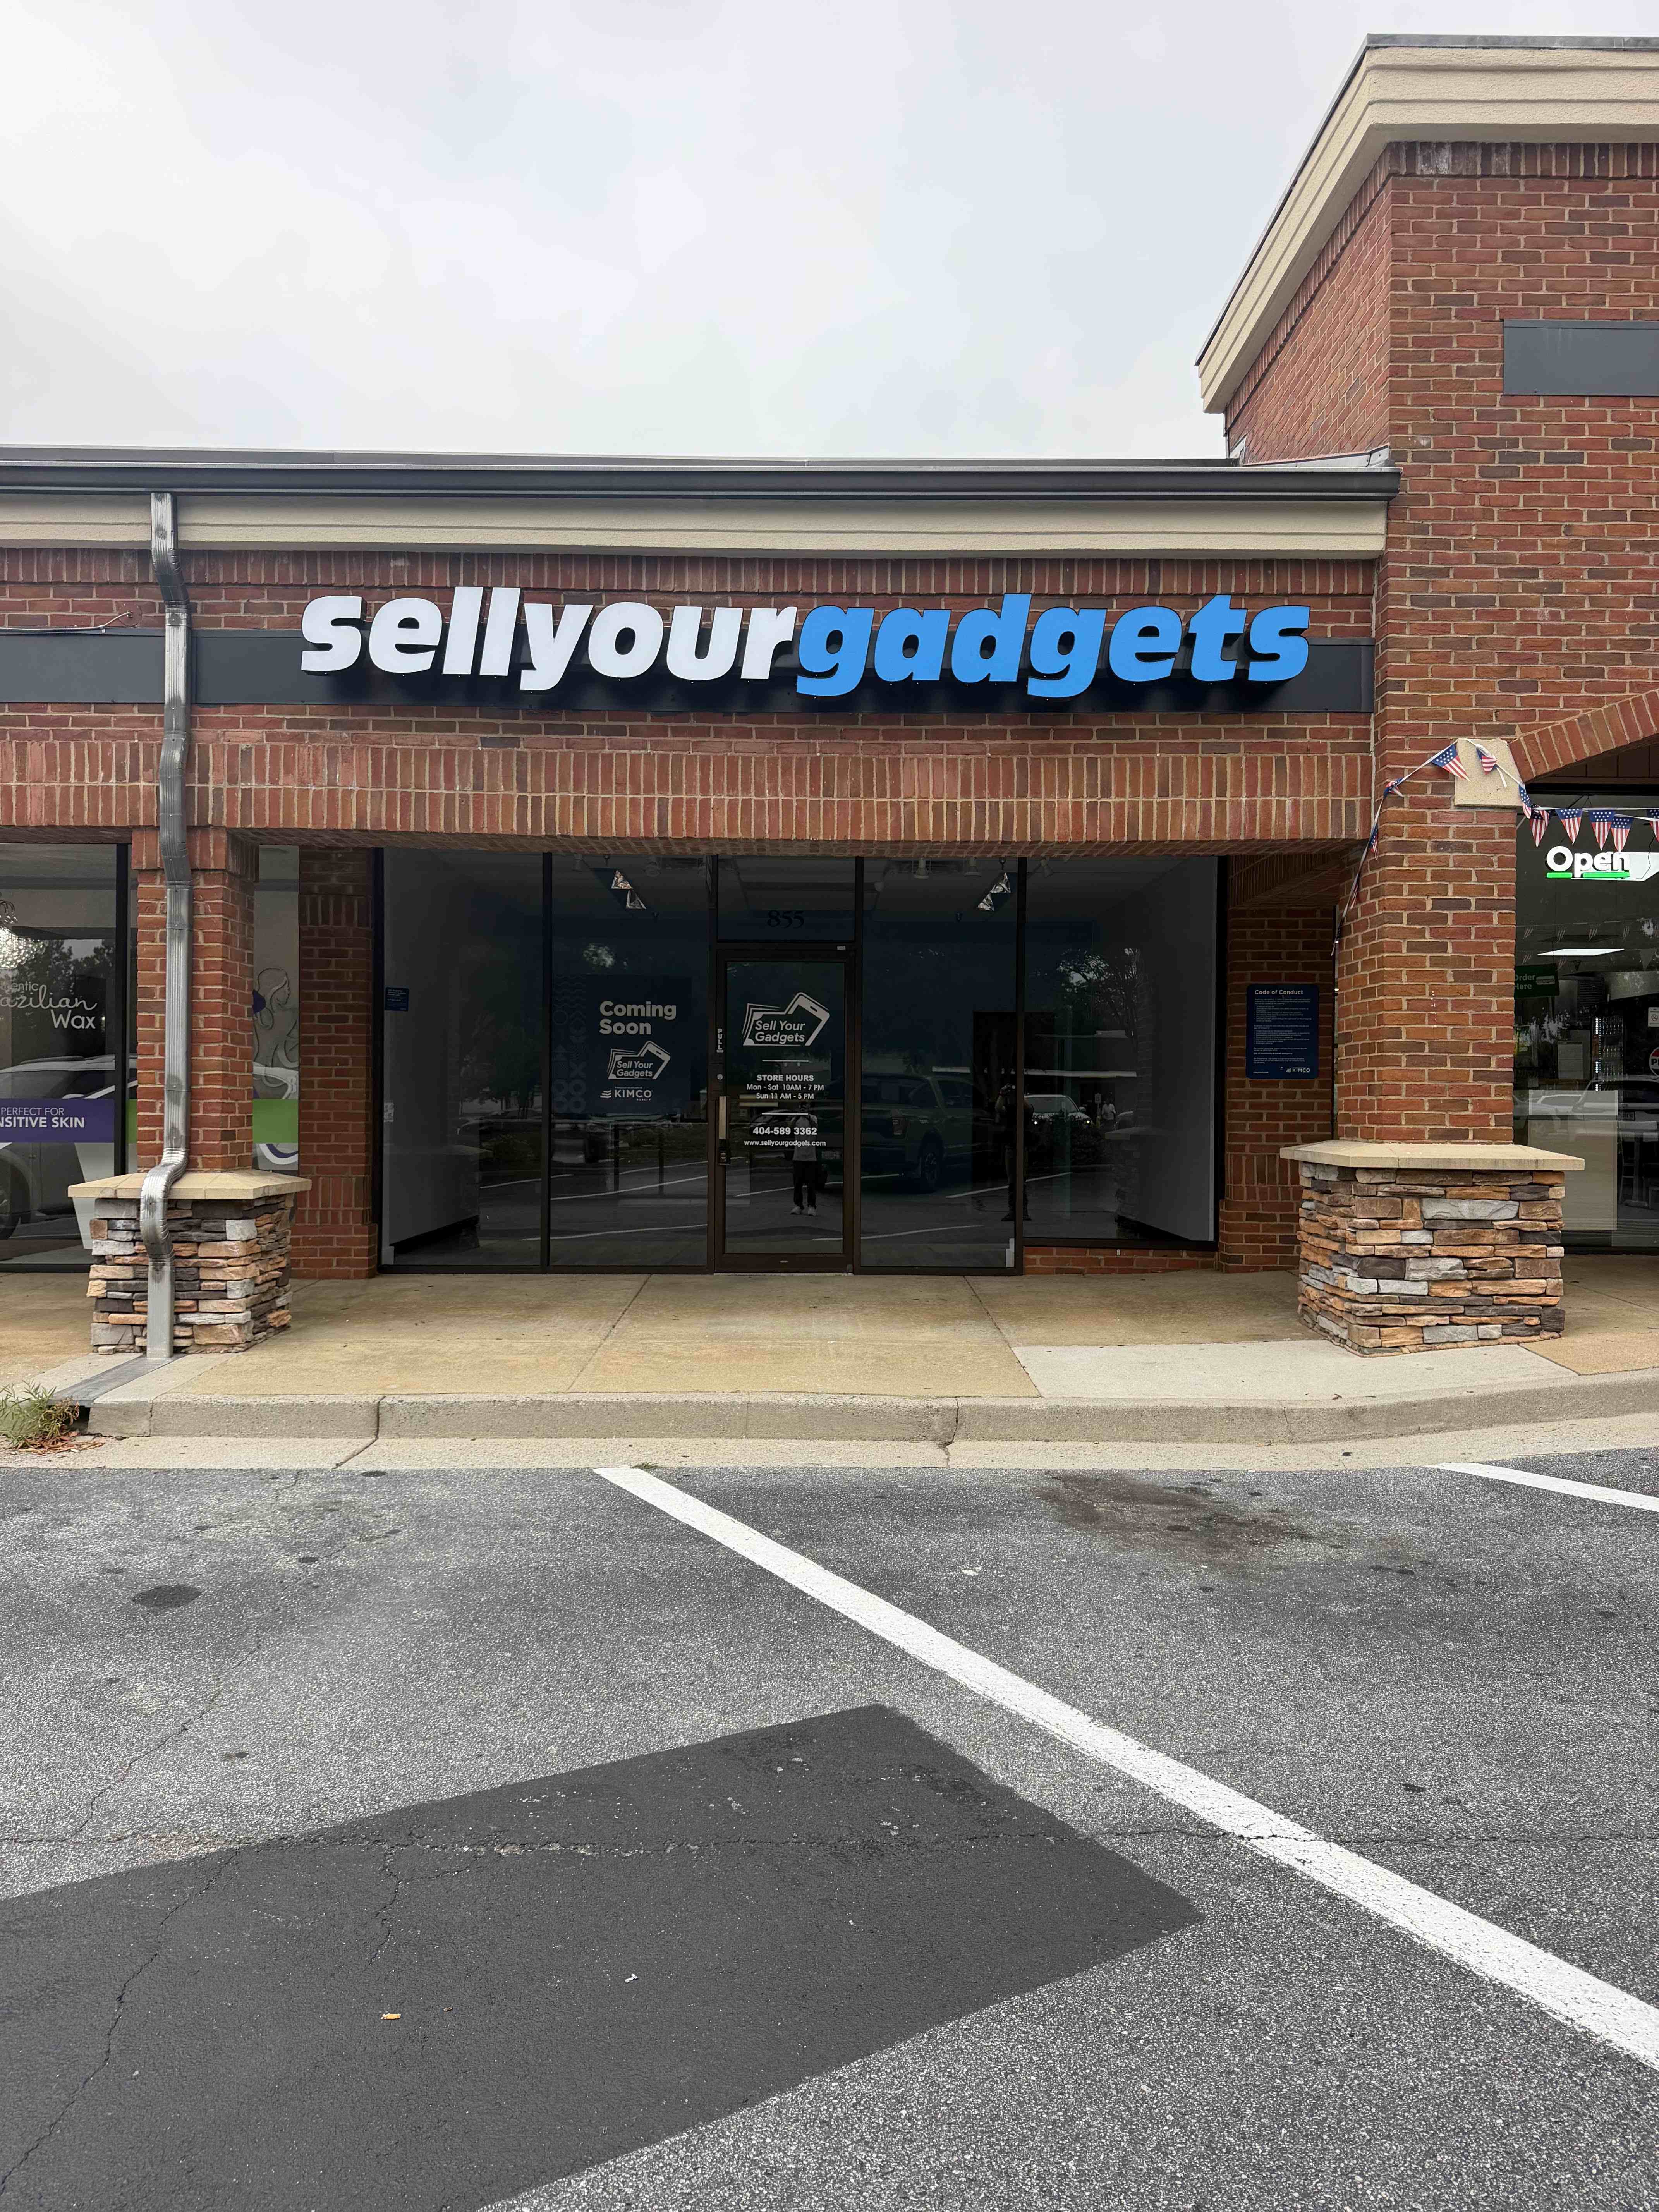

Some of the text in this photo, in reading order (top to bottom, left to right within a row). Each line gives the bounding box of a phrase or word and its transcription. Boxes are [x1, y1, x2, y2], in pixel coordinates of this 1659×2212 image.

[301, 586, 1311, 697] sellyourgadgets
[1546, 846, 1630, 878] Open
[767, 910, 804, 928] 855
[599, 1000, 676, 1020] Coming
[50, 1009, 96, 1029] Wax
[599, 1018, 651, 1035] Soon
[755, 1020, 806, 1031] Sell Your
[755, 1031, 805, 1044] Gadgets
[617, 1061, 653, 1069] Sell Your
[617, 1069, 653, 1078] Gadgets
[615, 1089, 652, 1098] KIMCO
[1, 1107, 65, 1116] PERFECT FOR
[52, 1117, 85, 1128] SKIN
[752, 1127, 817, 1135] 404-589 3362
